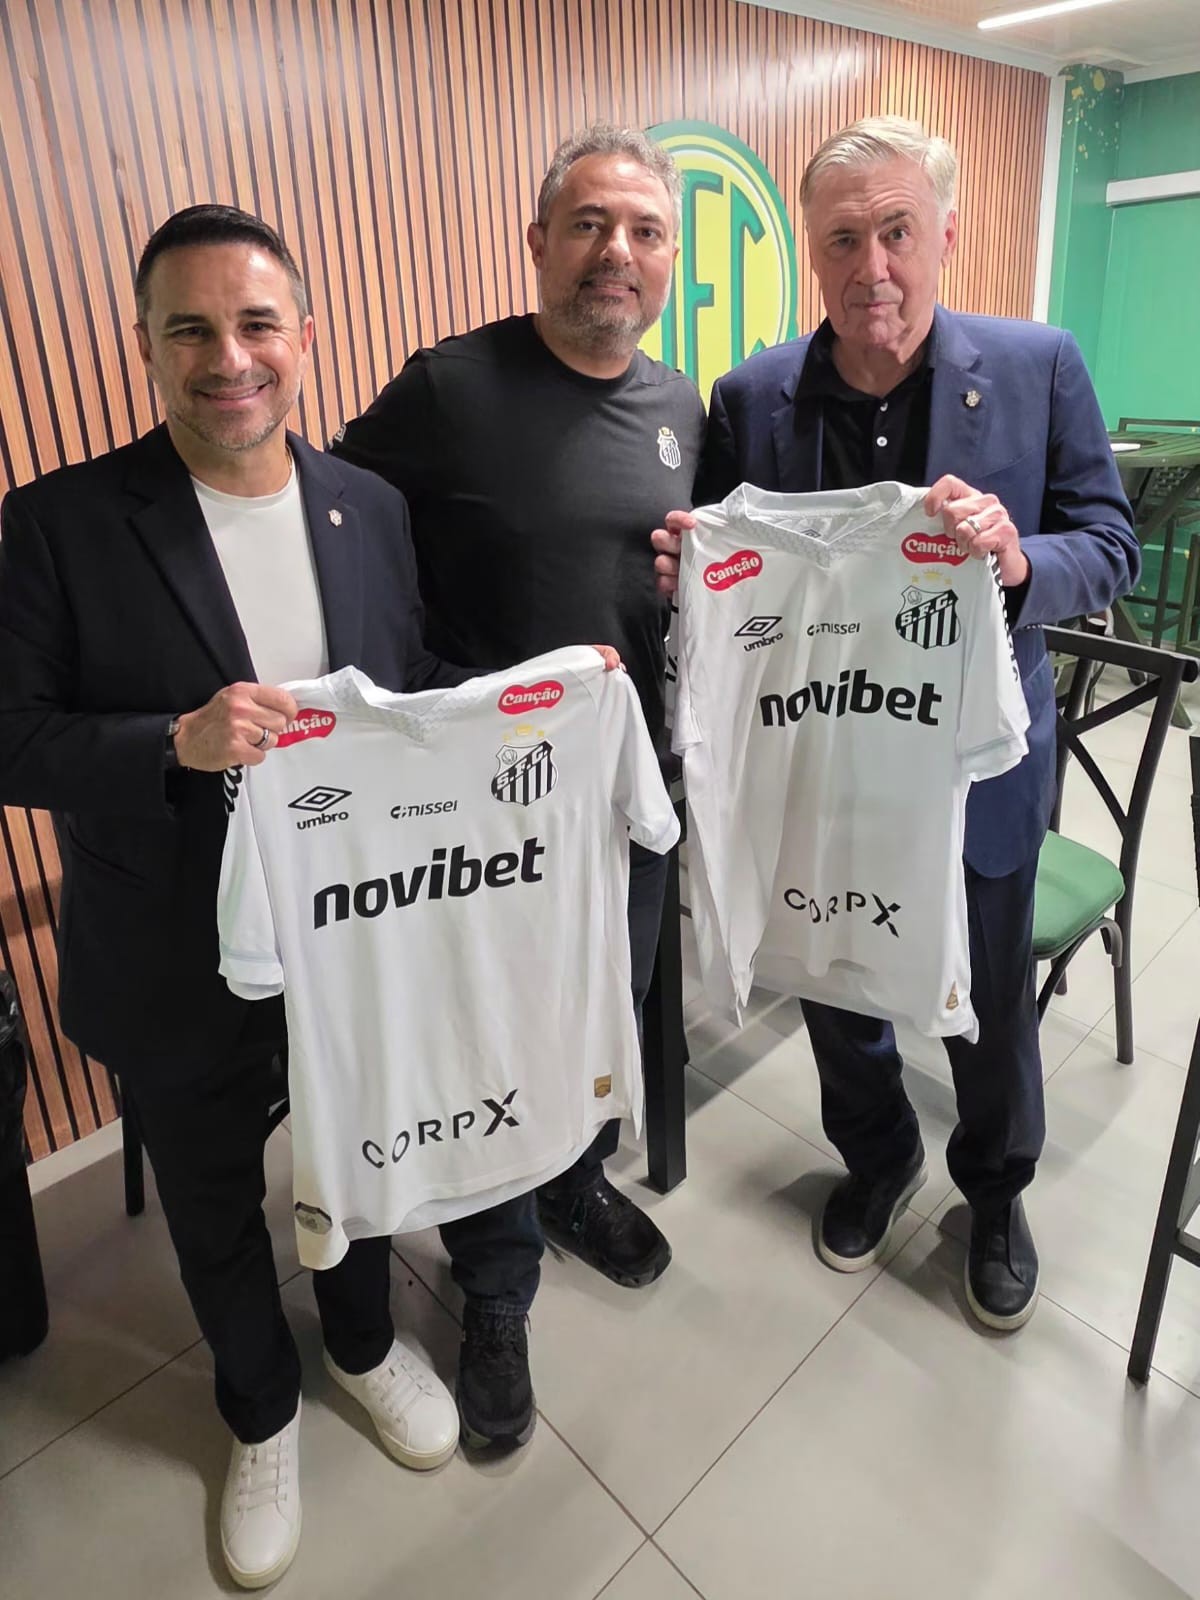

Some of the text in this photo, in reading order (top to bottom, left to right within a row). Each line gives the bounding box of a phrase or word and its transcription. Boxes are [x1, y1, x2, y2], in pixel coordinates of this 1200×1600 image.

[707, 557, 759, 584] Canção
[745, 632, 783, 652] umbro
[502, 688, 561, 706] Canção
[760, 669, 942, 727] novibet
[297, 811, 349, 830] umbro
[314, 837, 545, 930] novibet
[362, 1088, 520, 1169] CORPX
